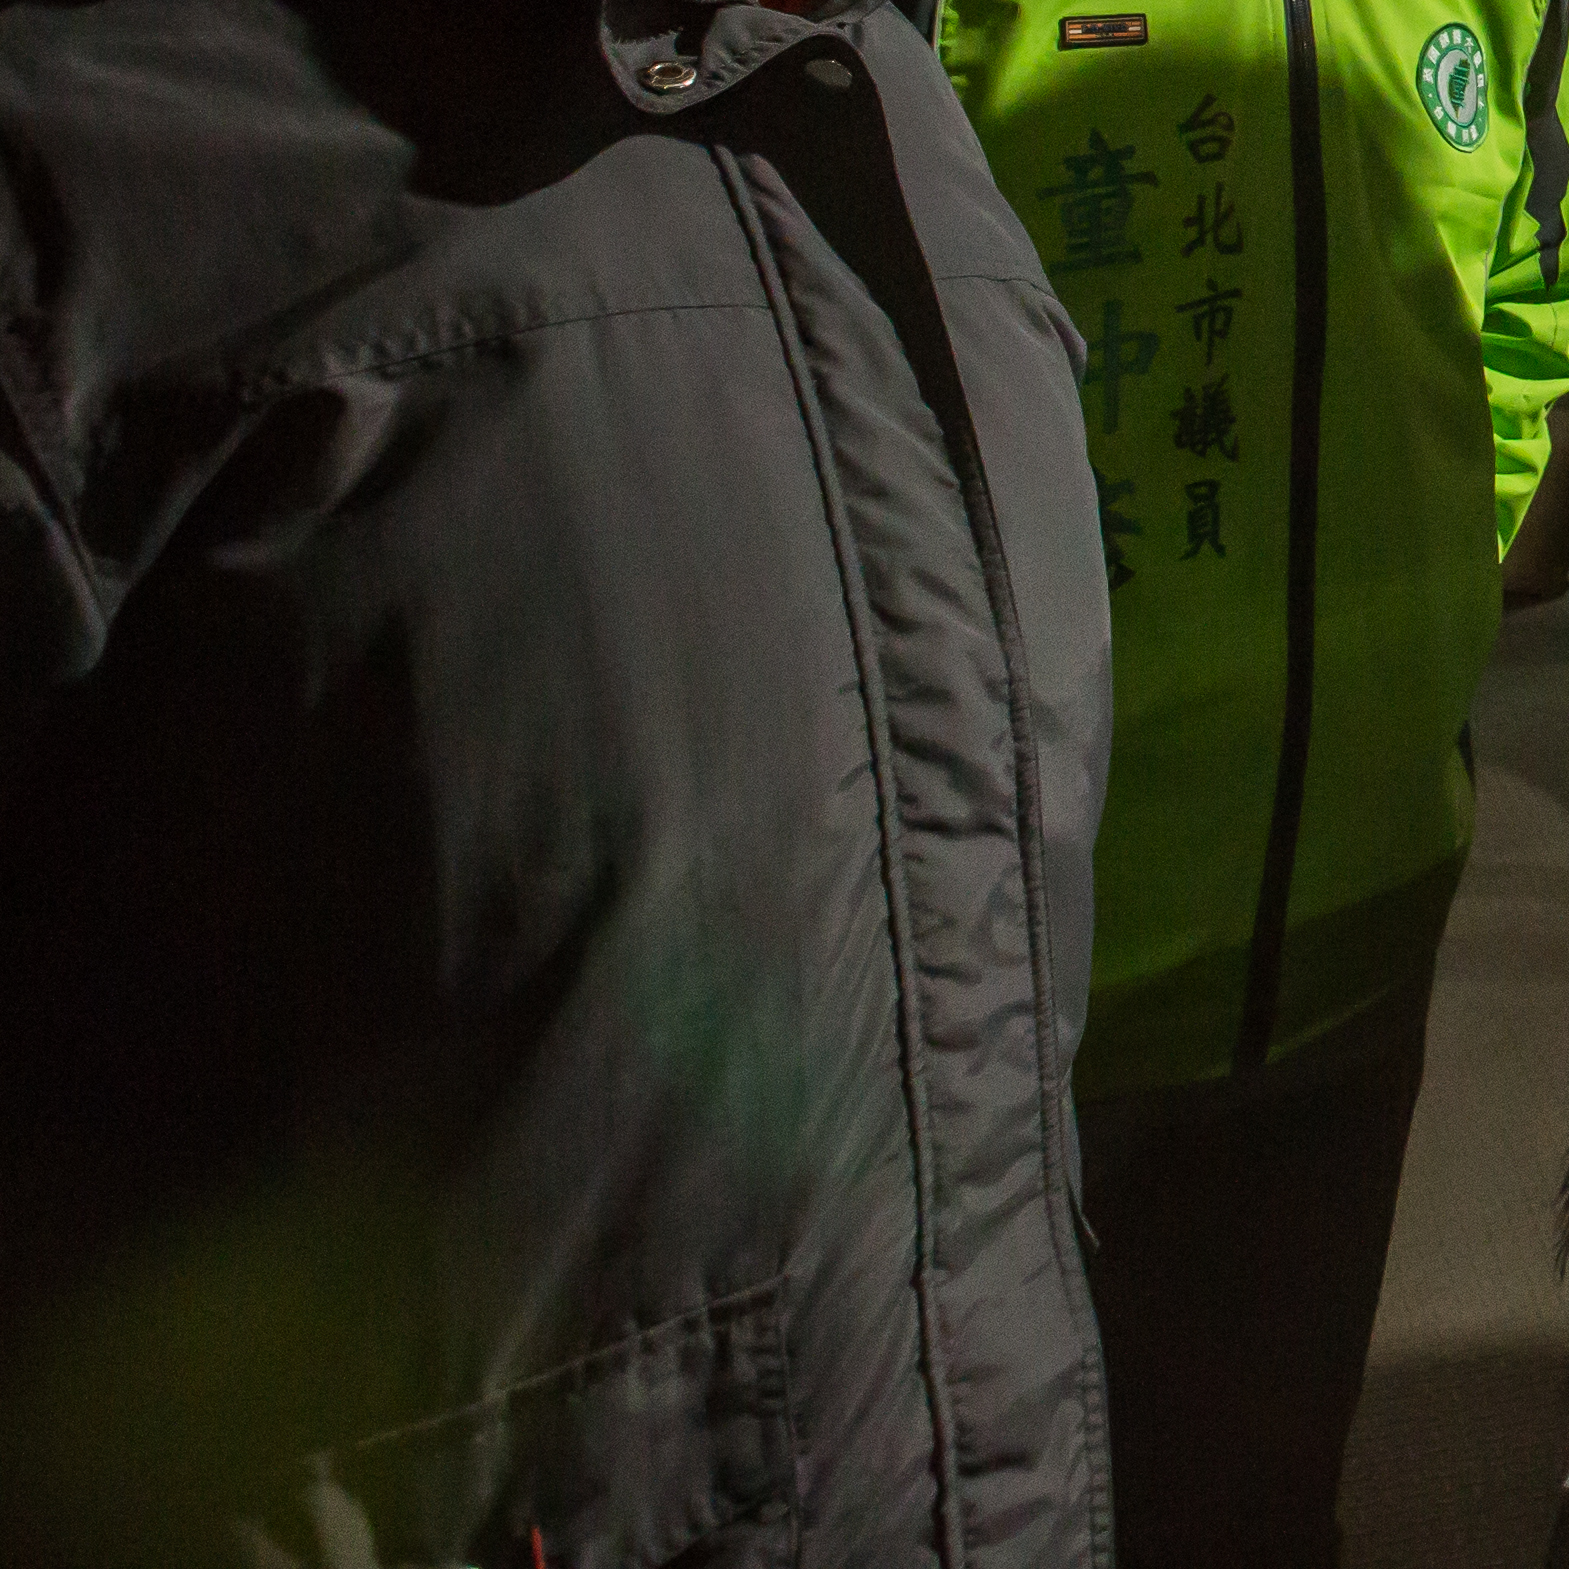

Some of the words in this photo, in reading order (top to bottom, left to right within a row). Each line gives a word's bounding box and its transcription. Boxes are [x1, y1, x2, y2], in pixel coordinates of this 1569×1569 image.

[1170, 92, 1244, 561] 台北市議員
